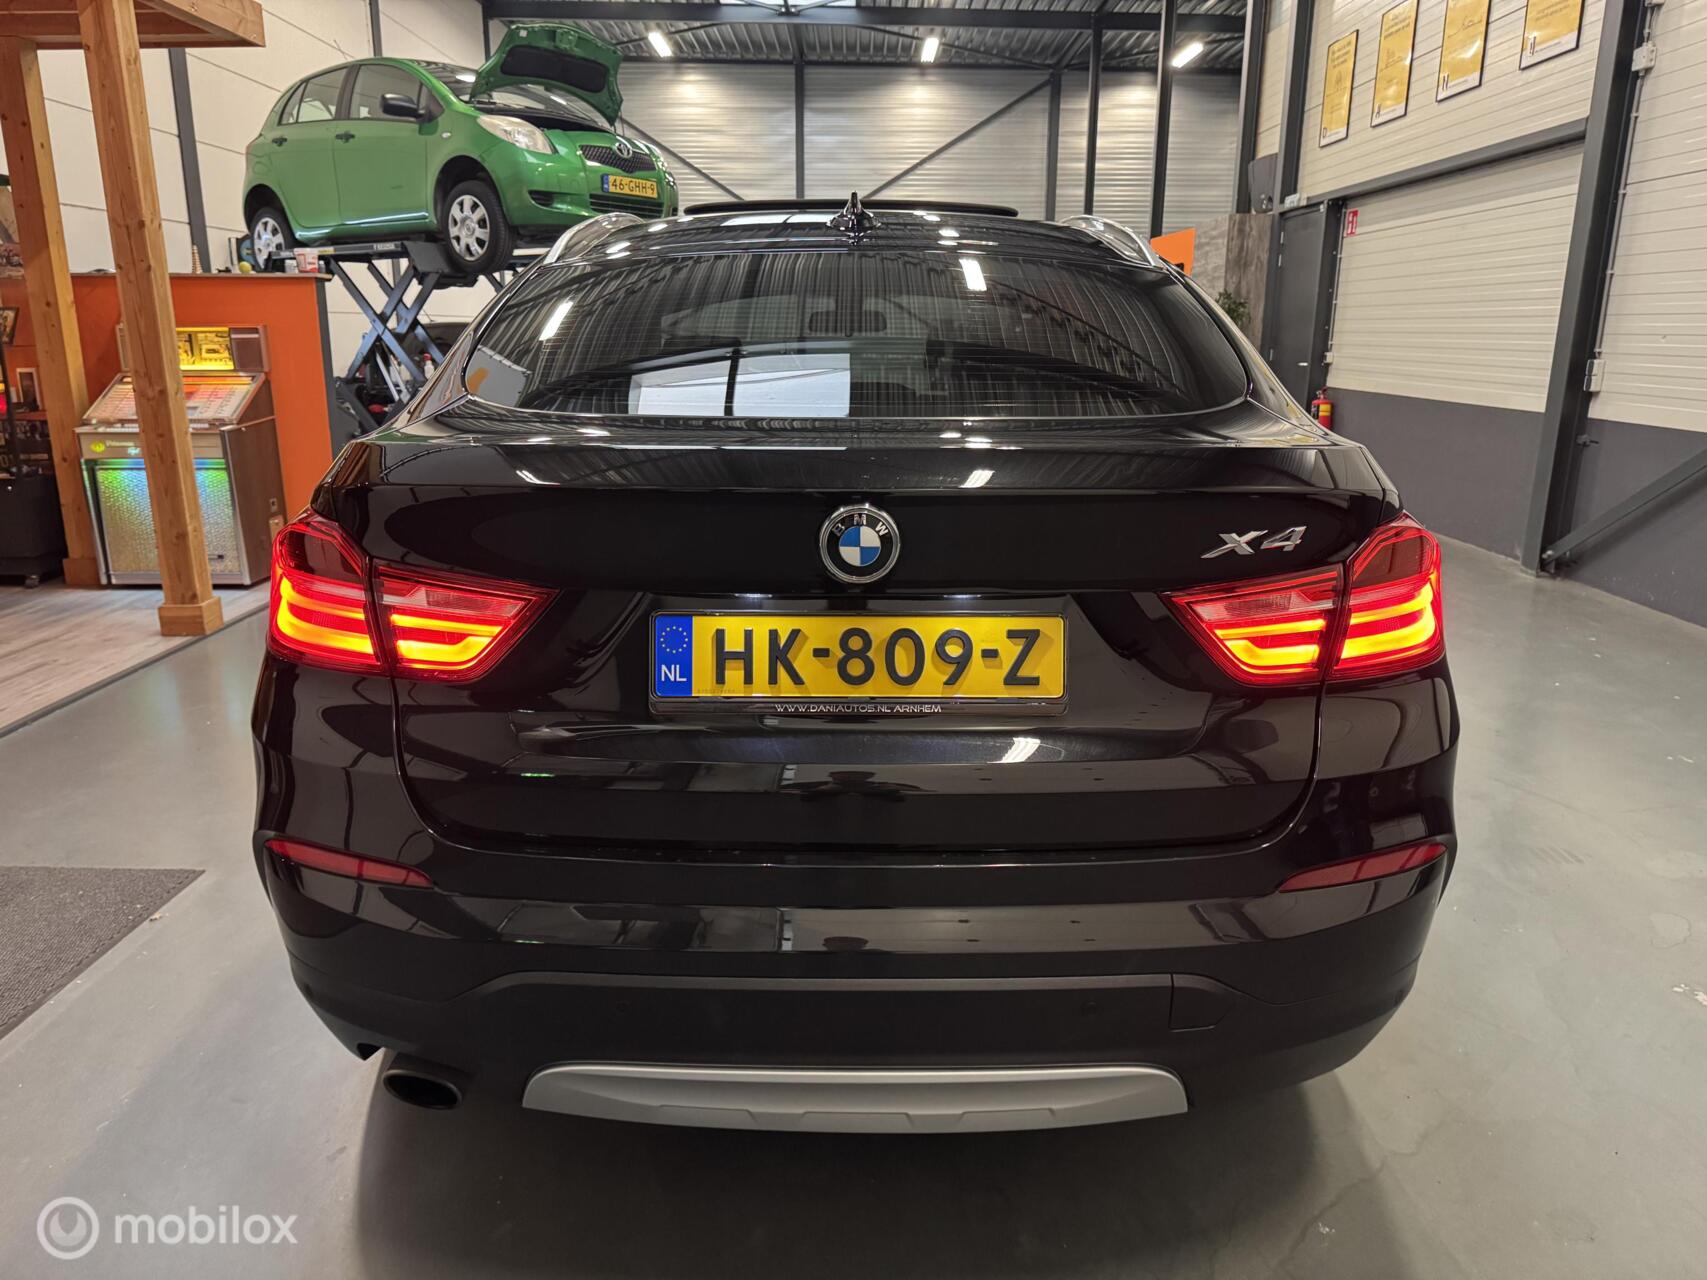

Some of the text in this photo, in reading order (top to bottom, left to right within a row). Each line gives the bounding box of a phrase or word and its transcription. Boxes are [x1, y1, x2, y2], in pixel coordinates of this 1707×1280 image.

[611, 178, 656, 195] 46-GHH-9
[832, 513, 889, 537] BMW
[1200, 526, 1307, 559] X4
[714, 627, 1041, 686] HK-809-Z
[660, 664, 688, 682] NL
[775, 703, 942, 713] WWW.DANIAUTOS.NL ARNHEM
